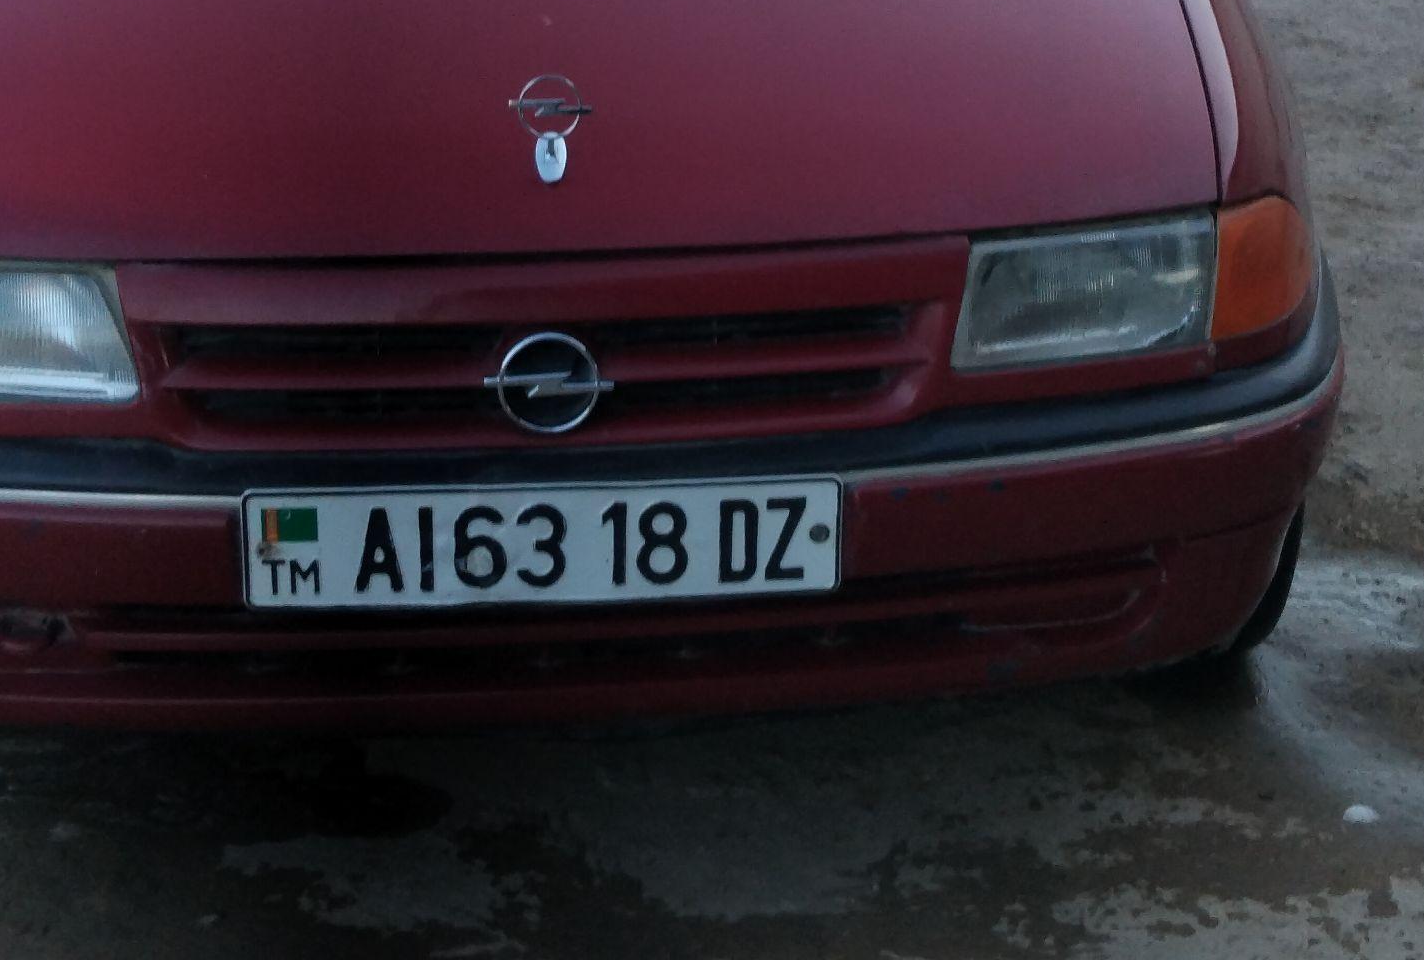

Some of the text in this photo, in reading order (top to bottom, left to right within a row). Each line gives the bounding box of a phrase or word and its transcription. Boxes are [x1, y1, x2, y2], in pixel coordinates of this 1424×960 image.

[601, 501, 689, 585] 18
[718, 497, 808, 584] DZ
[261, 559, 321, 596] TM
